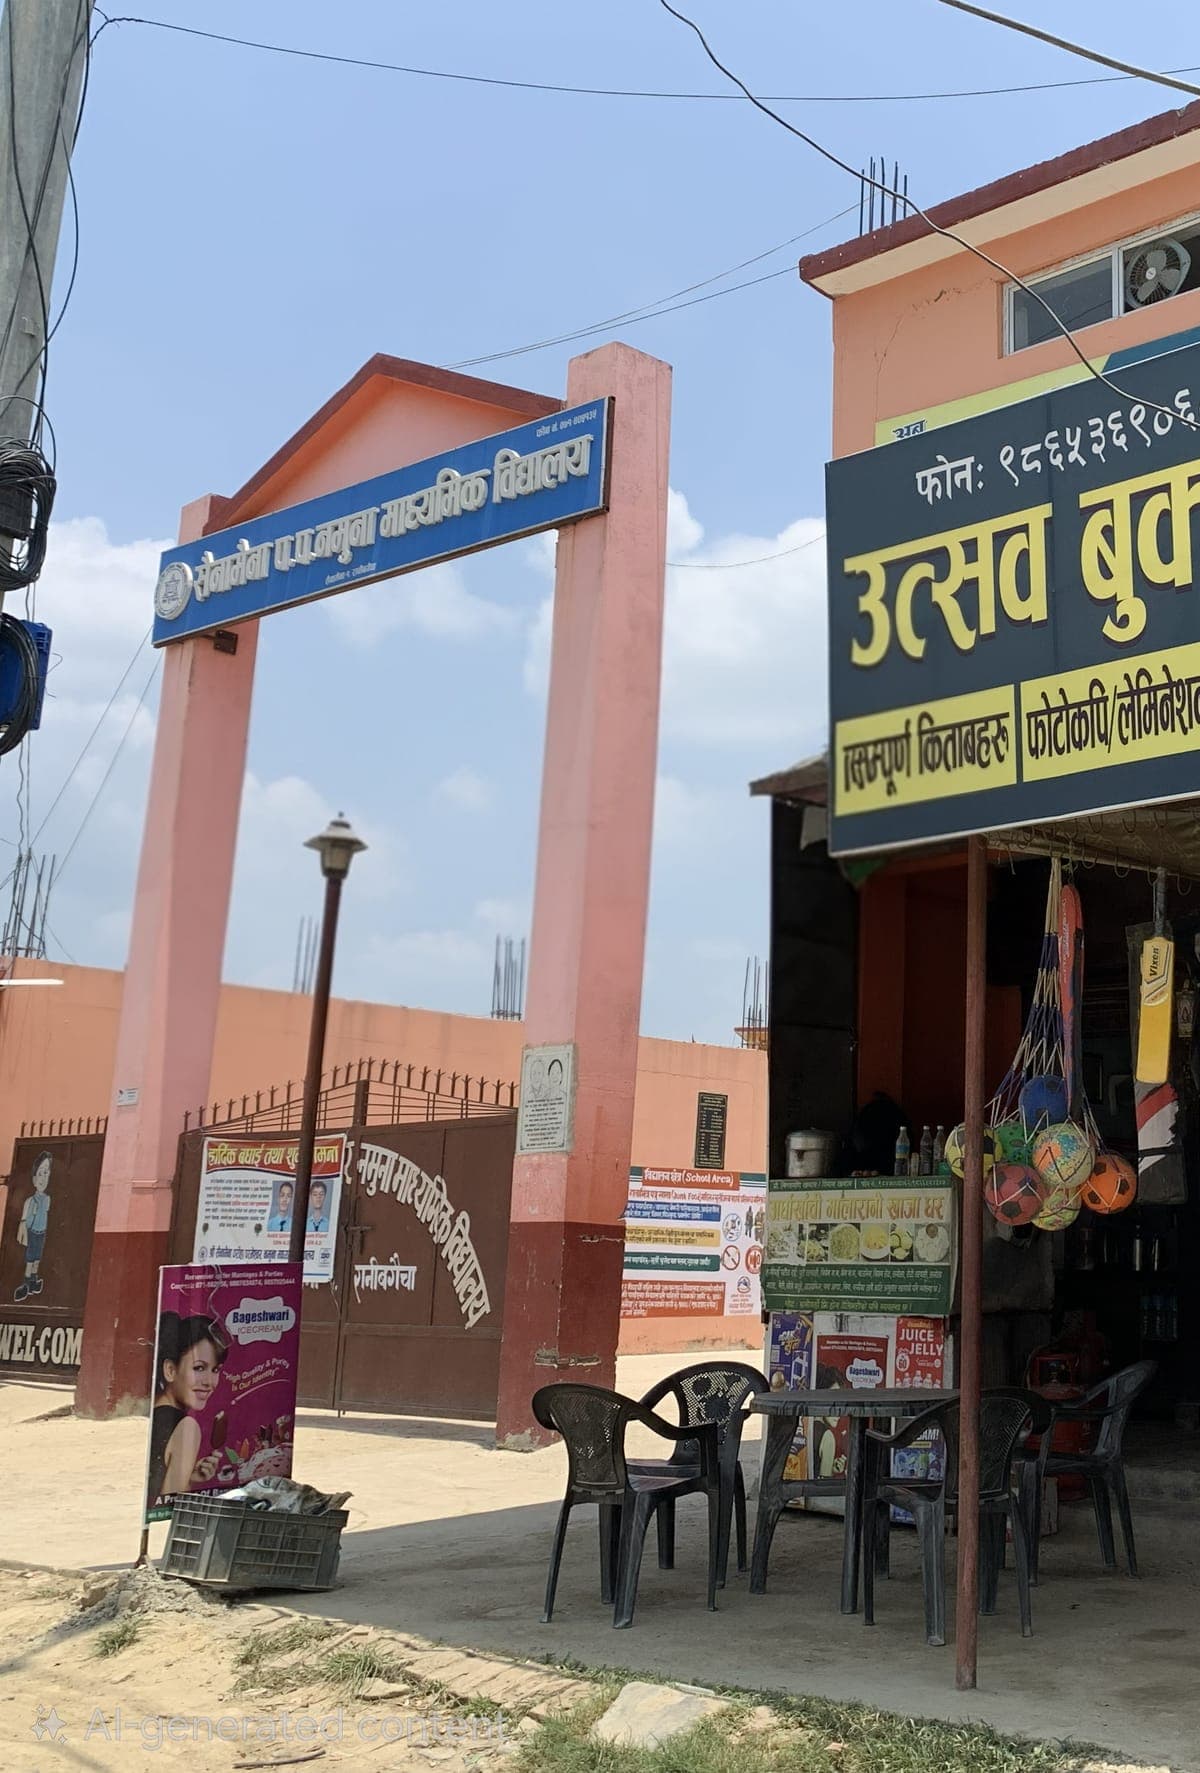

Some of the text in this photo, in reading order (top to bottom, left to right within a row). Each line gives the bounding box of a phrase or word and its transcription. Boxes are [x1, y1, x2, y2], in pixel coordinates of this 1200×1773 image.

[379, 467, 491, 538] माध्यमिक
[492, 433, 594, 504] विद्यालय
[843, 502, 1053, 668] उत्सव
[264, 1146, 286, 1165] तथा
[356, 1142, 399, 1197] नमुना
[232, 1309, 289, 1324] Bageshwari
[899, 1328, 934, 1343] JUICE
[908, 1343, 944, 1357] JELLY
